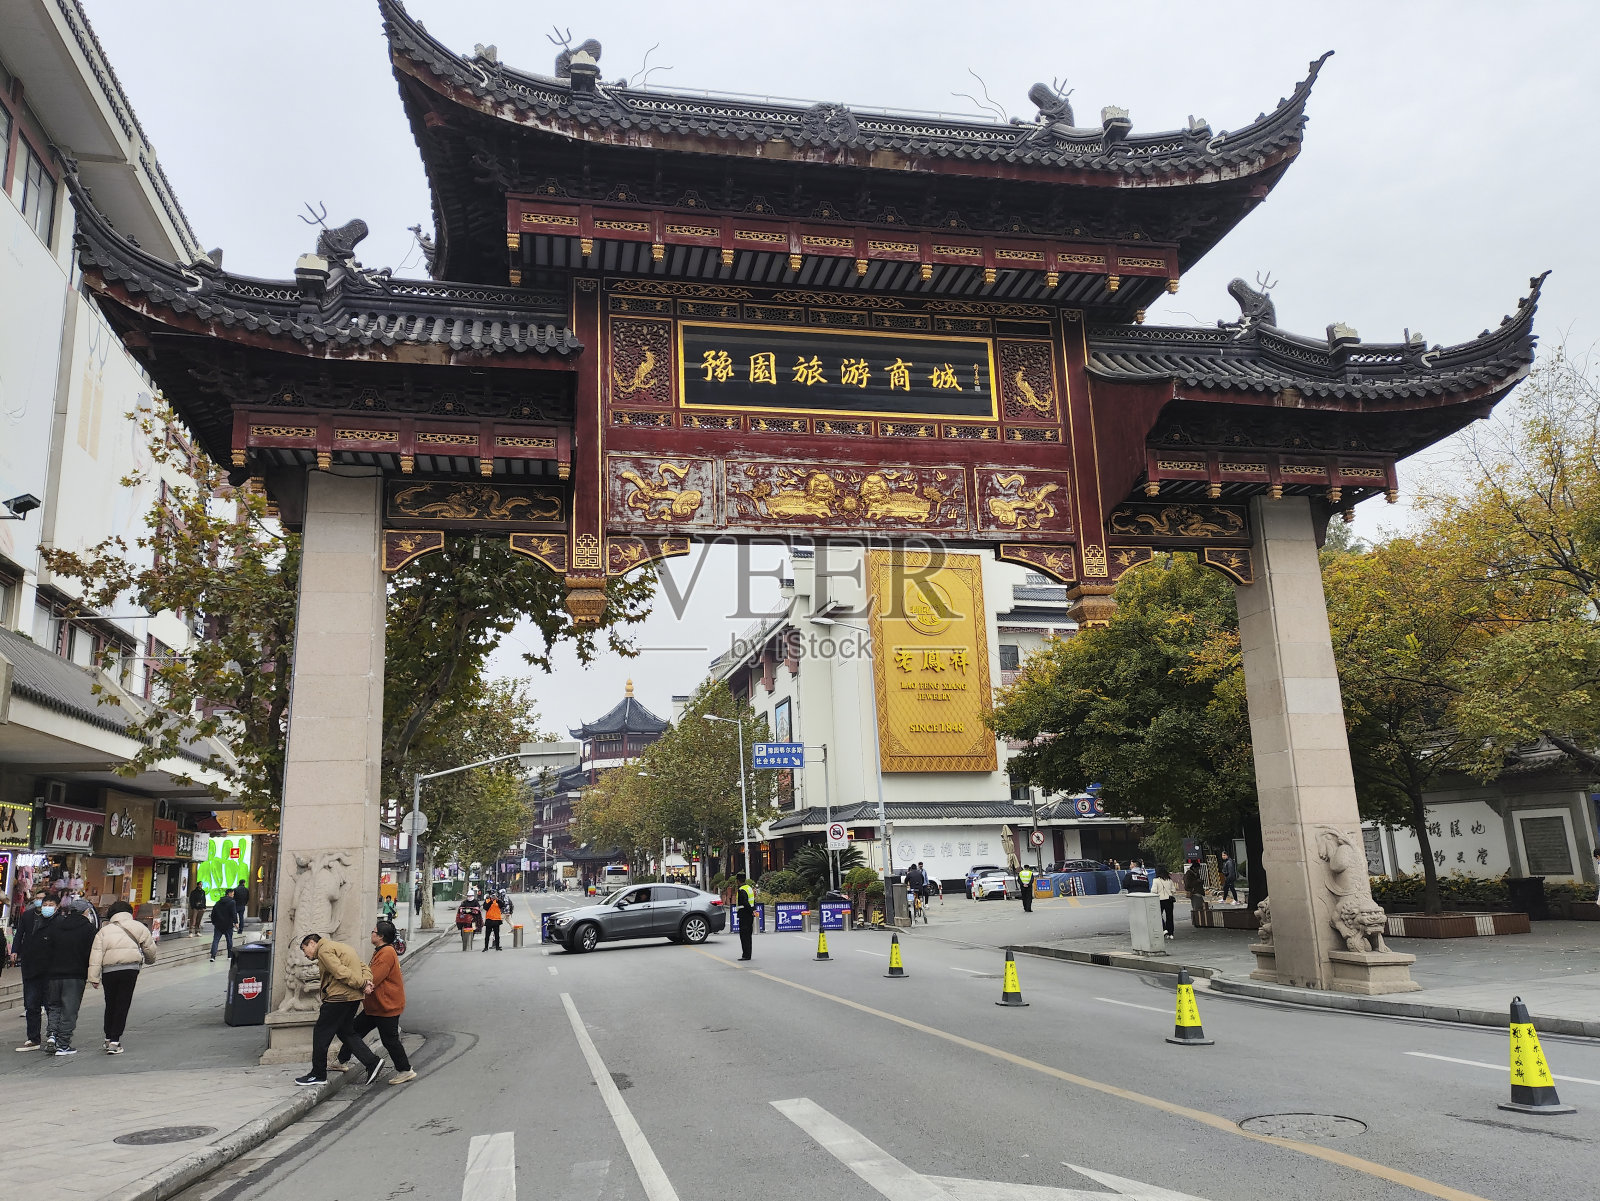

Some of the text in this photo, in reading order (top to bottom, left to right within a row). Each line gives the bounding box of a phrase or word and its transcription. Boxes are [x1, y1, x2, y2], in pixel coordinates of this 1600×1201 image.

[700, 349, 963, 392] 豫園旅游商城
[894, 647, 970, 676] 老鳳祥
[900, 681, 967, 691] LAO FENG XIANG
[917, 692, 951, 702] JEWELRY
[909, 721, 965, 733] SINCE 1848
[757, 746, 764, 755] P
[756, 757, 789, 765] 社会停车库
[1080, 801, 1087, 811] 5
